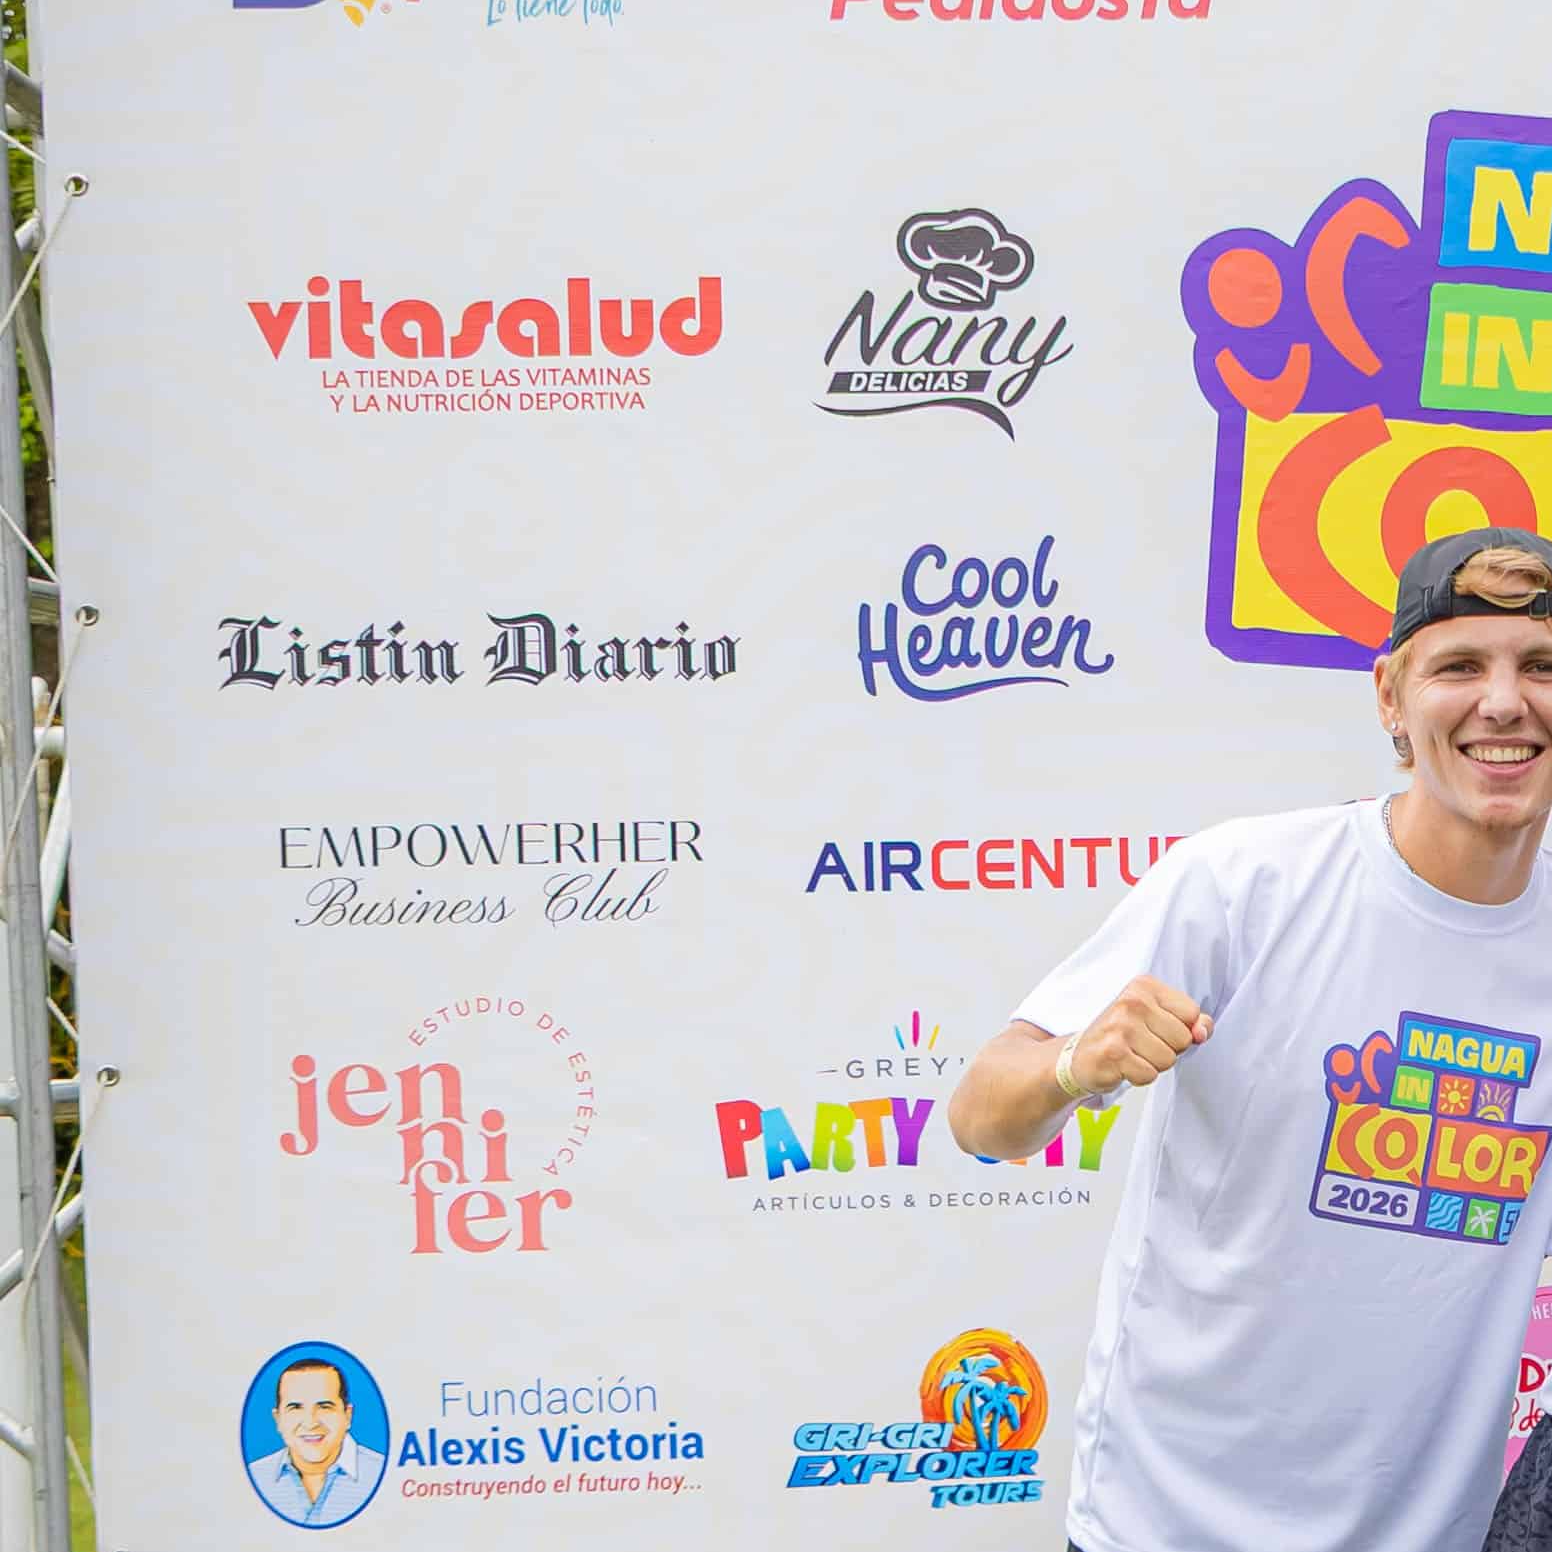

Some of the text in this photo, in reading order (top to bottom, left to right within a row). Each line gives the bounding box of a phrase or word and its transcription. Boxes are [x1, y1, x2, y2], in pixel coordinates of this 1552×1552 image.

[247, 275, 723, 361] vitasalud
[824, 289, 1075, 406] Nany
[321, 365, 652, 390] LA TIENDA DE LAS VITAMINAS
[330, 389, 647, 413] Y LA NUTRICIÓN DEPORTIVA
[849, 370, 971, 393] DELICIAS
[900, 533, 1060, 617] Cool
[215, 613, 742, 692] Listin Diario
[857, 601, 1116, 703] Heaven
[279, 819, 704, 871] EMPOWERHER
[805, 835, 1192, 893] AIRCENTU
[294, 868, 670, 929] Business Club
[1407, 1028, 1527, 1079] NAGUA
[408, 996, 599, 1176] ESTUDIO DE ESTÉTICA
[1396, 1074, 1430, 1104] IN
[714, 1096, 936, 1181] PARTY
[1336, 1102, 1538, 1194] COLOR
[752, 1186, 1093, 1212] ARTÍCULOS DECORACIÓN
[1328, 1183, 1409, 1218] 2026
[439, 1376, 658, 1418] Fundación
[397, 1419, 705, 1467] Alexis Victoria
[793, 1421, 954, 1452] GRI-GRI
[400, 1470, 703, 1501] Construyendo el futuro hoy...
[786, 1449, 1040, 1488] EXPLORER
[930, 1480, 1045, 1509] TOURS
